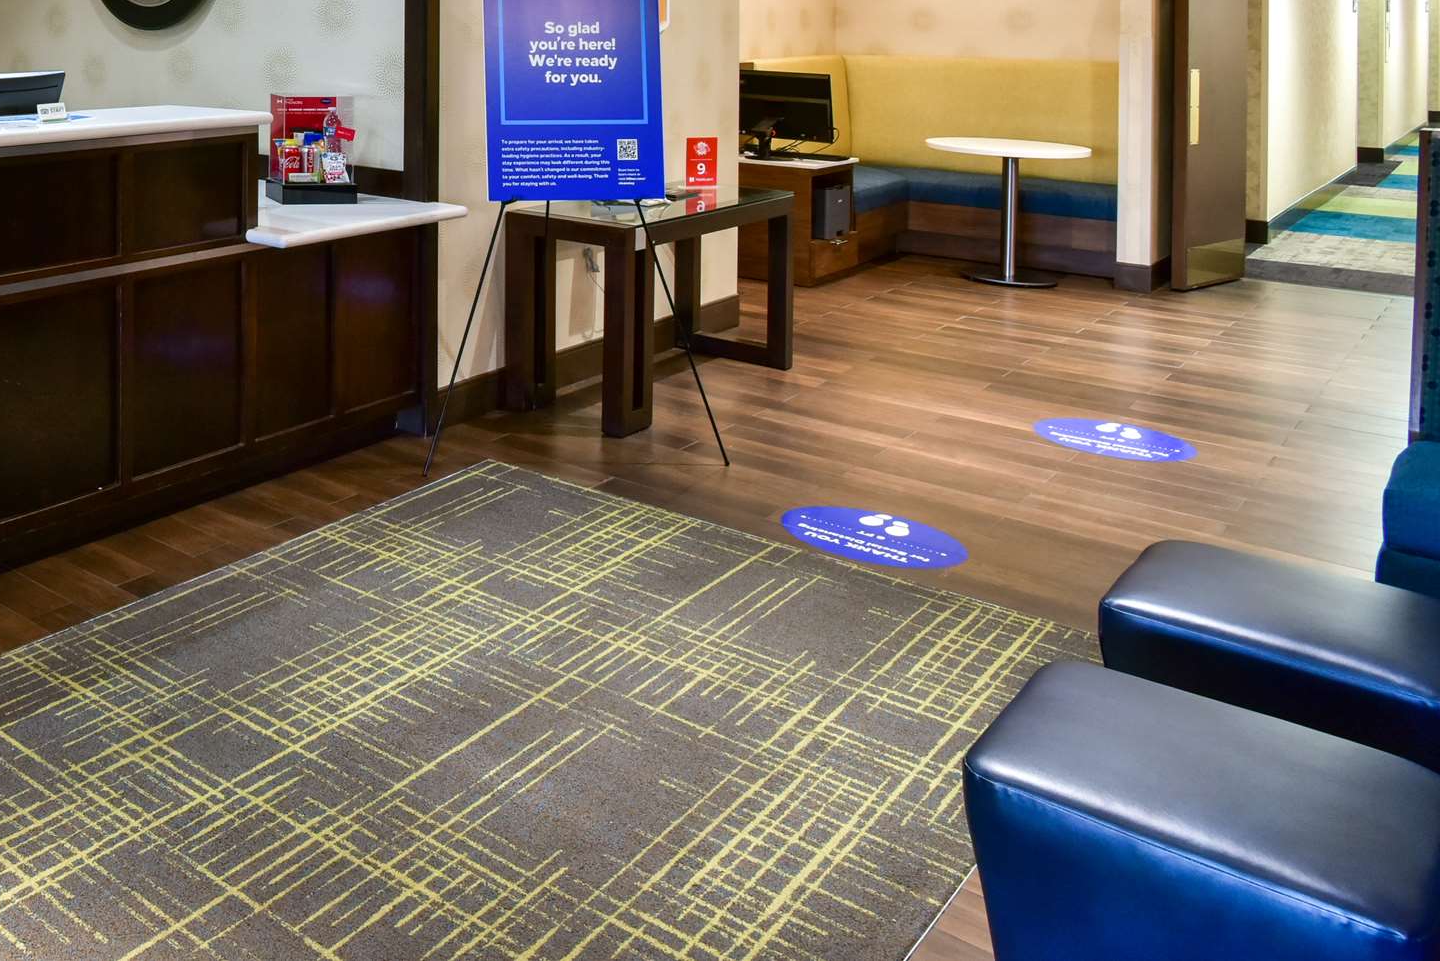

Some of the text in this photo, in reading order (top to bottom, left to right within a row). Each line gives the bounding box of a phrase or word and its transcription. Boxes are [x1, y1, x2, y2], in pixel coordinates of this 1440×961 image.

[544, 21, 600, 37] So glad
[529, 36, 616, 54] you're here!
[528, 54, 618, 70] We're ready
[544, 70, 602, 86] for you.
[697, 163, 705, 174] 9
[803, 531, 909, 564] THANK YOU
